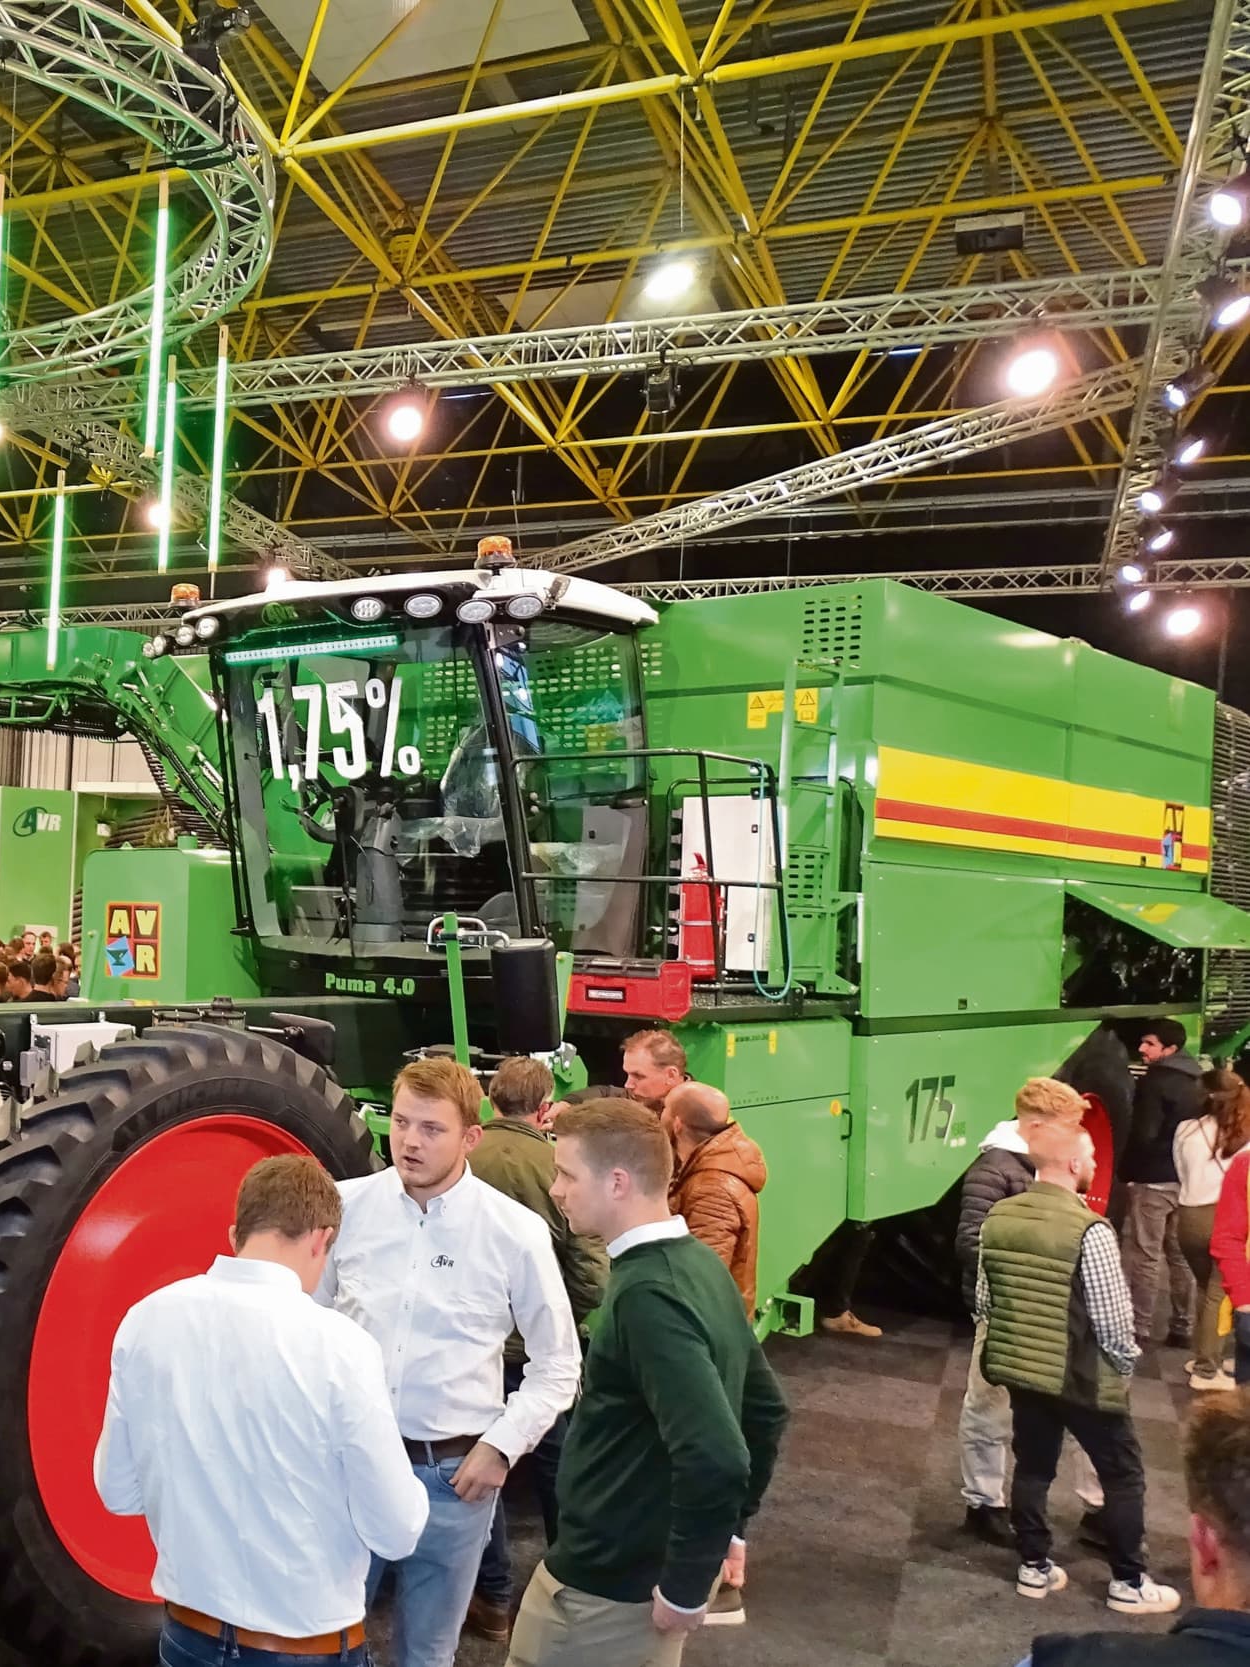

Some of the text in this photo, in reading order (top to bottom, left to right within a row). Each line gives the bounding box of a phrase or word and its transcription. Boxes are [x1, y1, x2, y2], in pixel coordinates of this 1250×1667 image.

[256, 676, 422, 792] 1,75%
[13, 806, 62, 837] AVR
[325, 972, 416, 996] Puma 4.0
[430, 1254, 455, 1269] AVR
